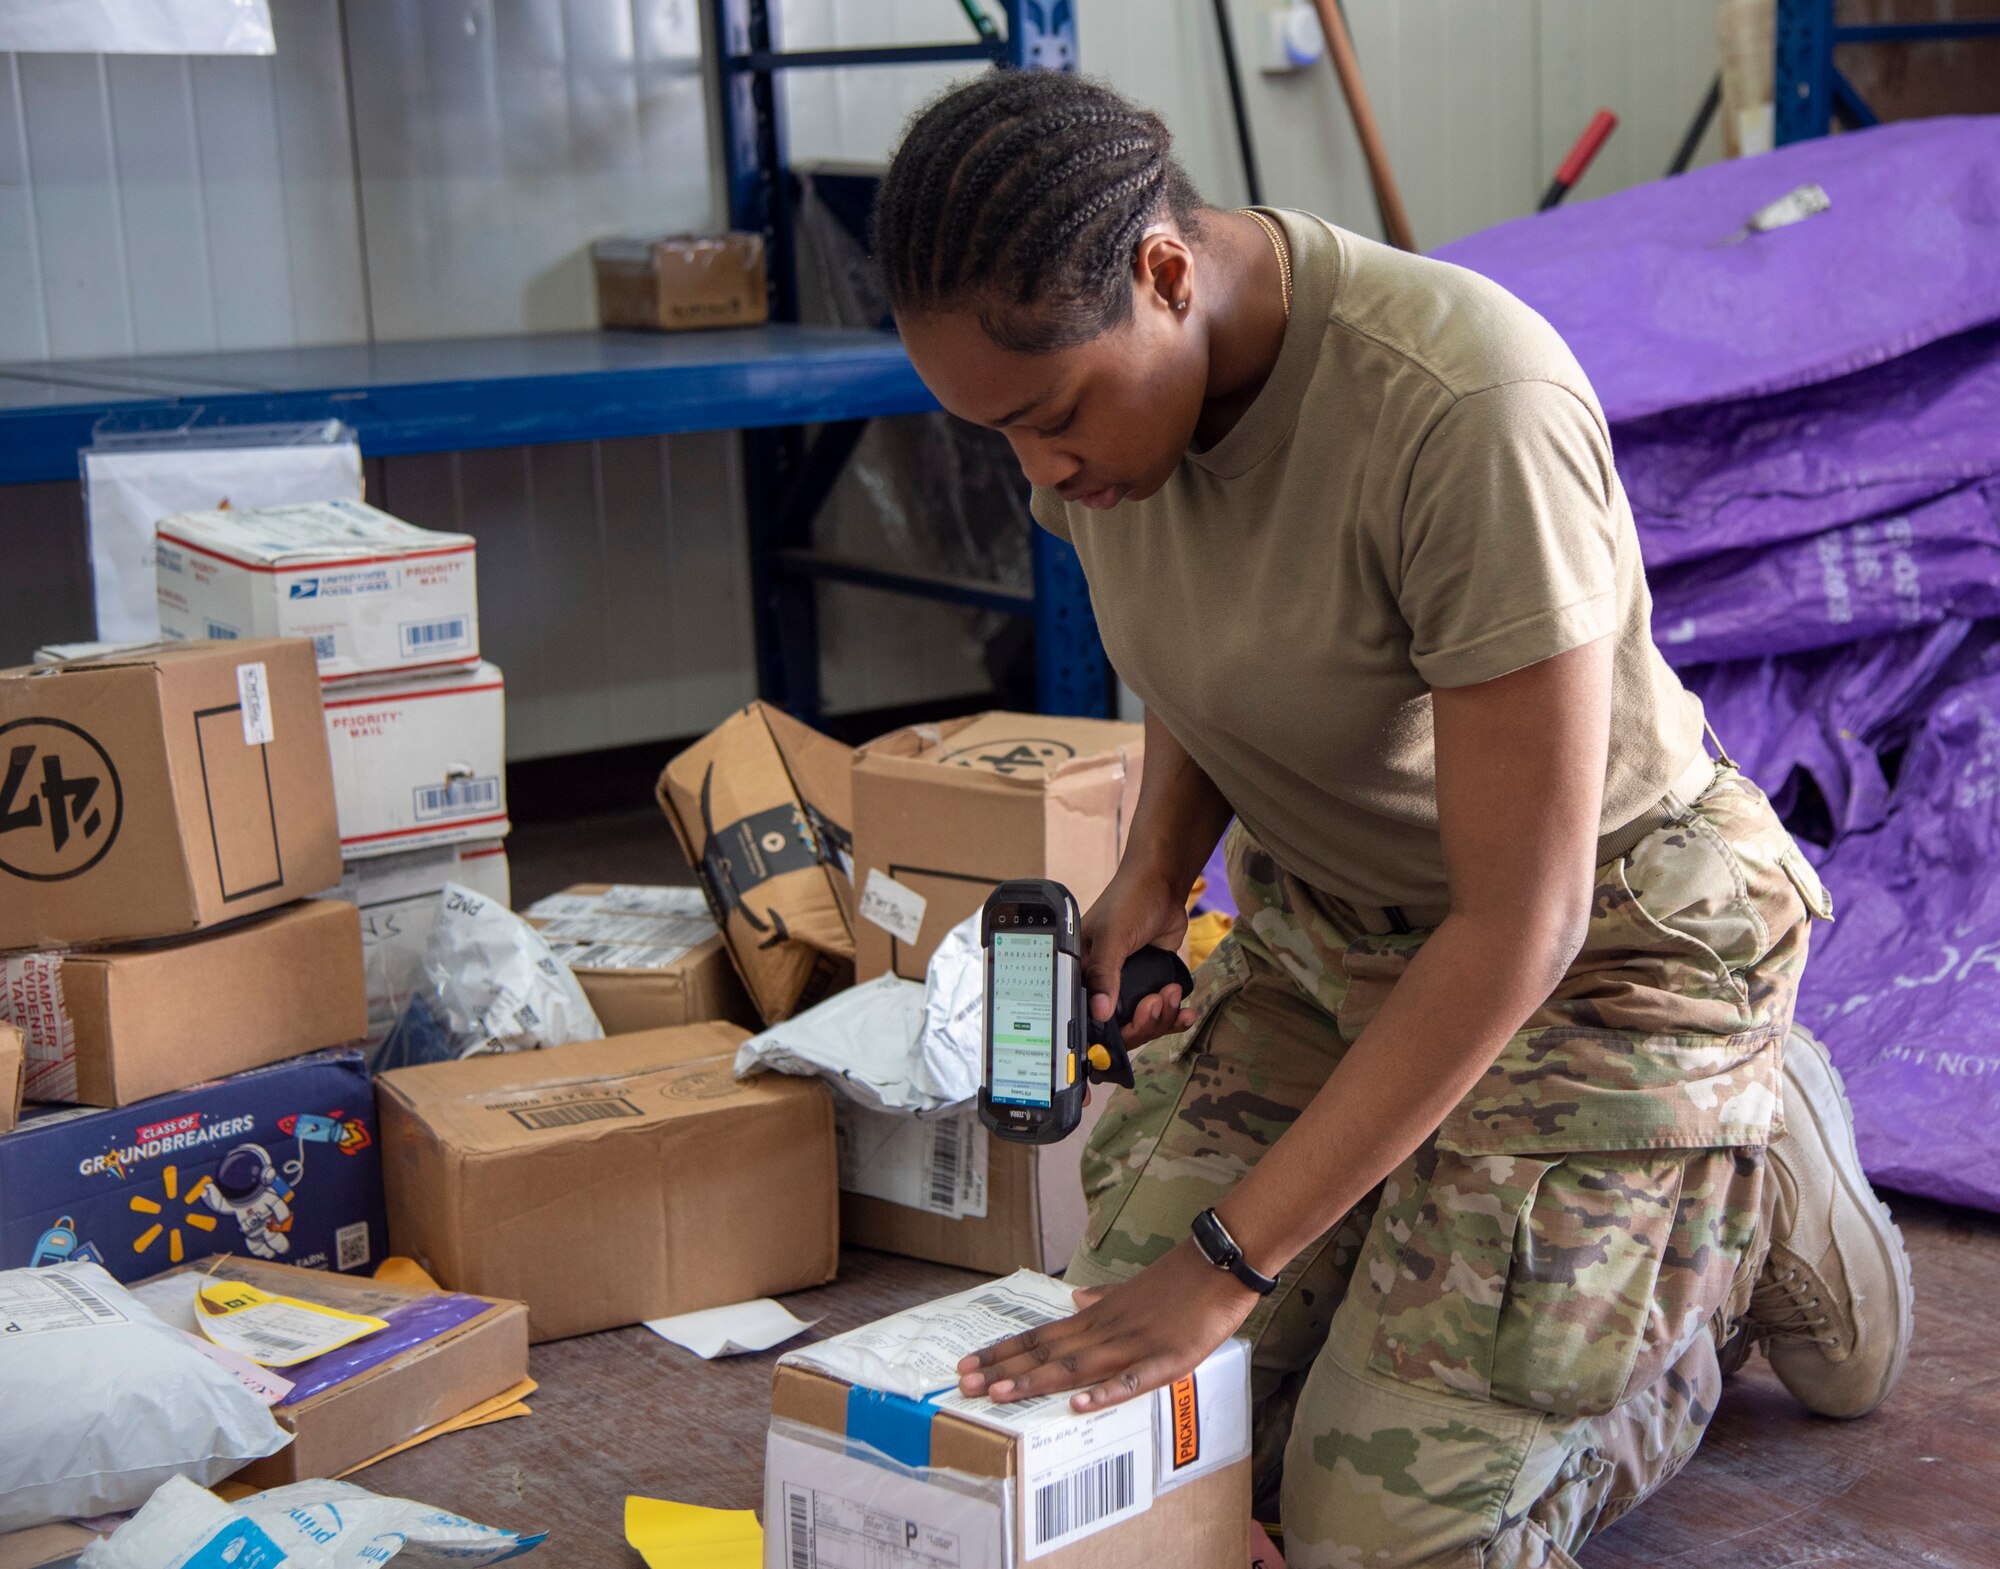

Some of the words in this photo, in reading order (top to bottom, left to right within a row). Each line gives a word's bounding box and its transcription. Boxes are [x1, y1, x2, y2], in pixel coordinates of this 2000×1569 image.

[405, 562, 462, 578] PRIORITY
[420, 576, 448, 586] MAIL
[332, 711, 399, 729] PRIORITY
[350, 727, 383, 738] MAIL
[12, 977, 28, 1028] TAPE
[24, 960, 43, 1046] EVIDENT
[38, 962, 58, 1048] TAMPER
[141, 1122, 177, 1141] CLASS
[178, 1116, 195, 1132] OF
[5, 1321, 22, 1333] P
[1178, 1394, 1193, 1459] PACKING
[905, 1519, 918, 1547] P
